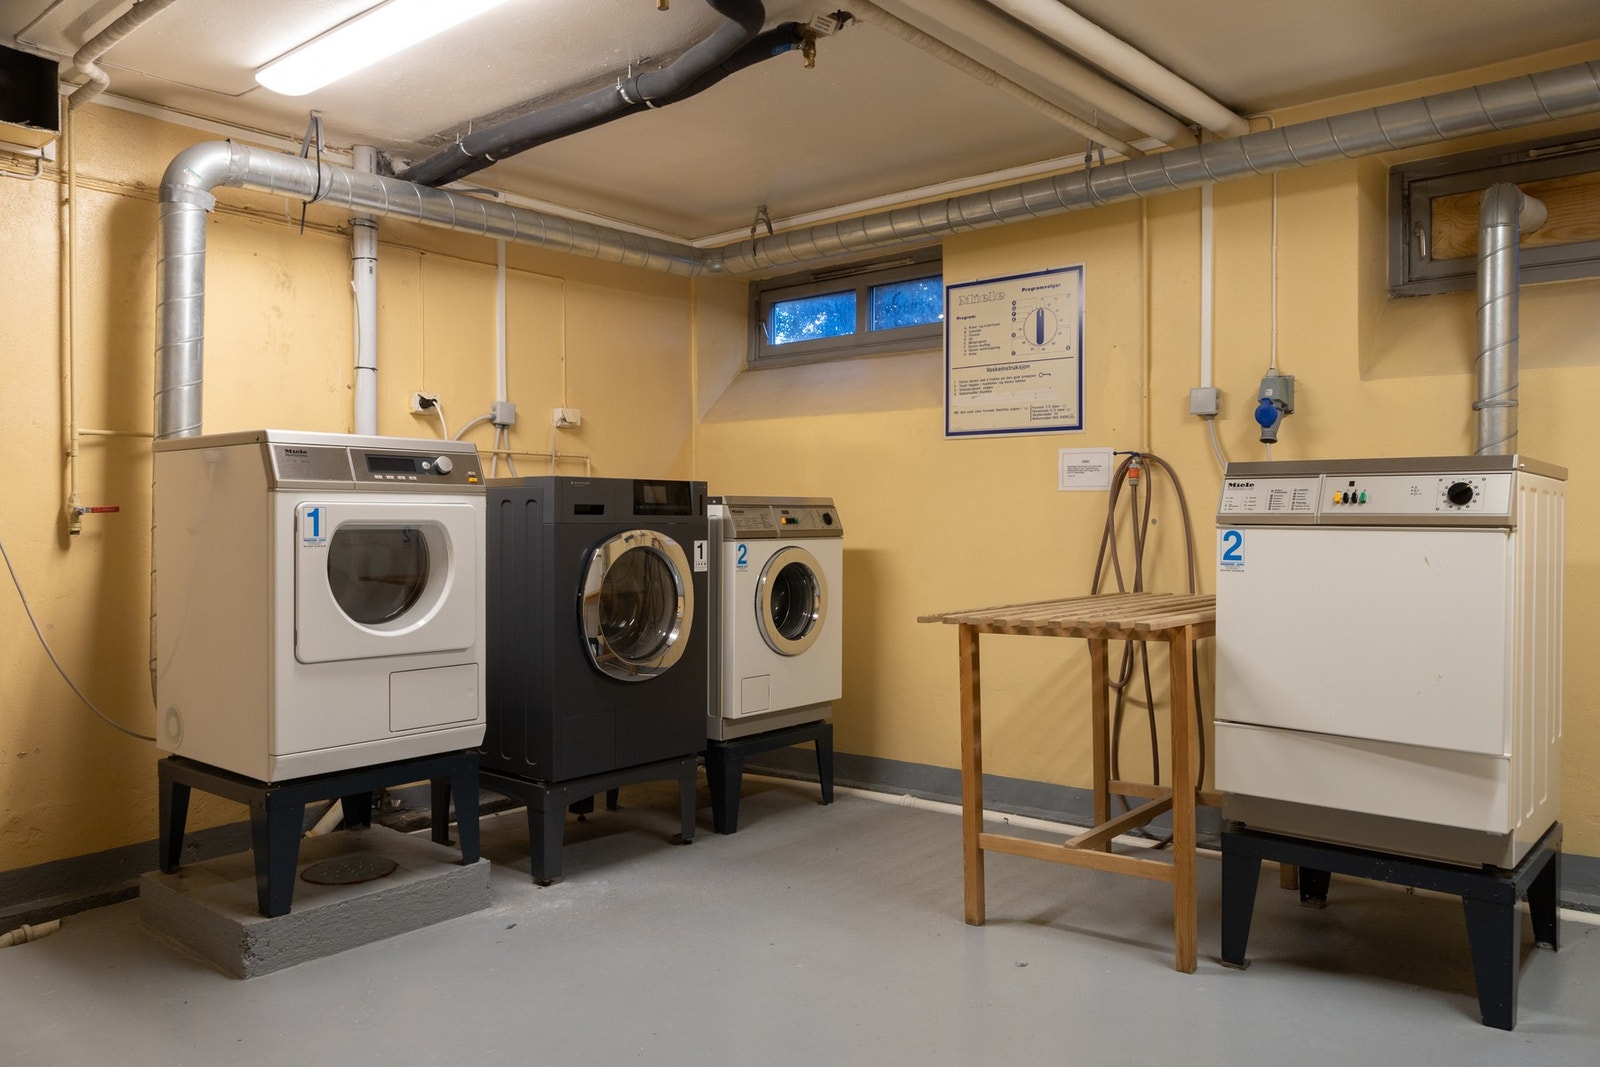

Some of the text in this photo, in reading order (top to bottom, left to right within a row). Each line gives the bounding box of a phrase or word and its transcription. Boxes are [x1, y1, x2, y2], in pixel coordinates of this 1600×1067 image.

[958, 292, 1006, 306] Miele
[986, 364, 1030, 373] Vaskeinstruksjon
[307, 508, 319, 536] 1
[697, 542, 703, 559] 1
[738, 543, 747, 564] 2
[1223, 530, 1242, 561] 2
